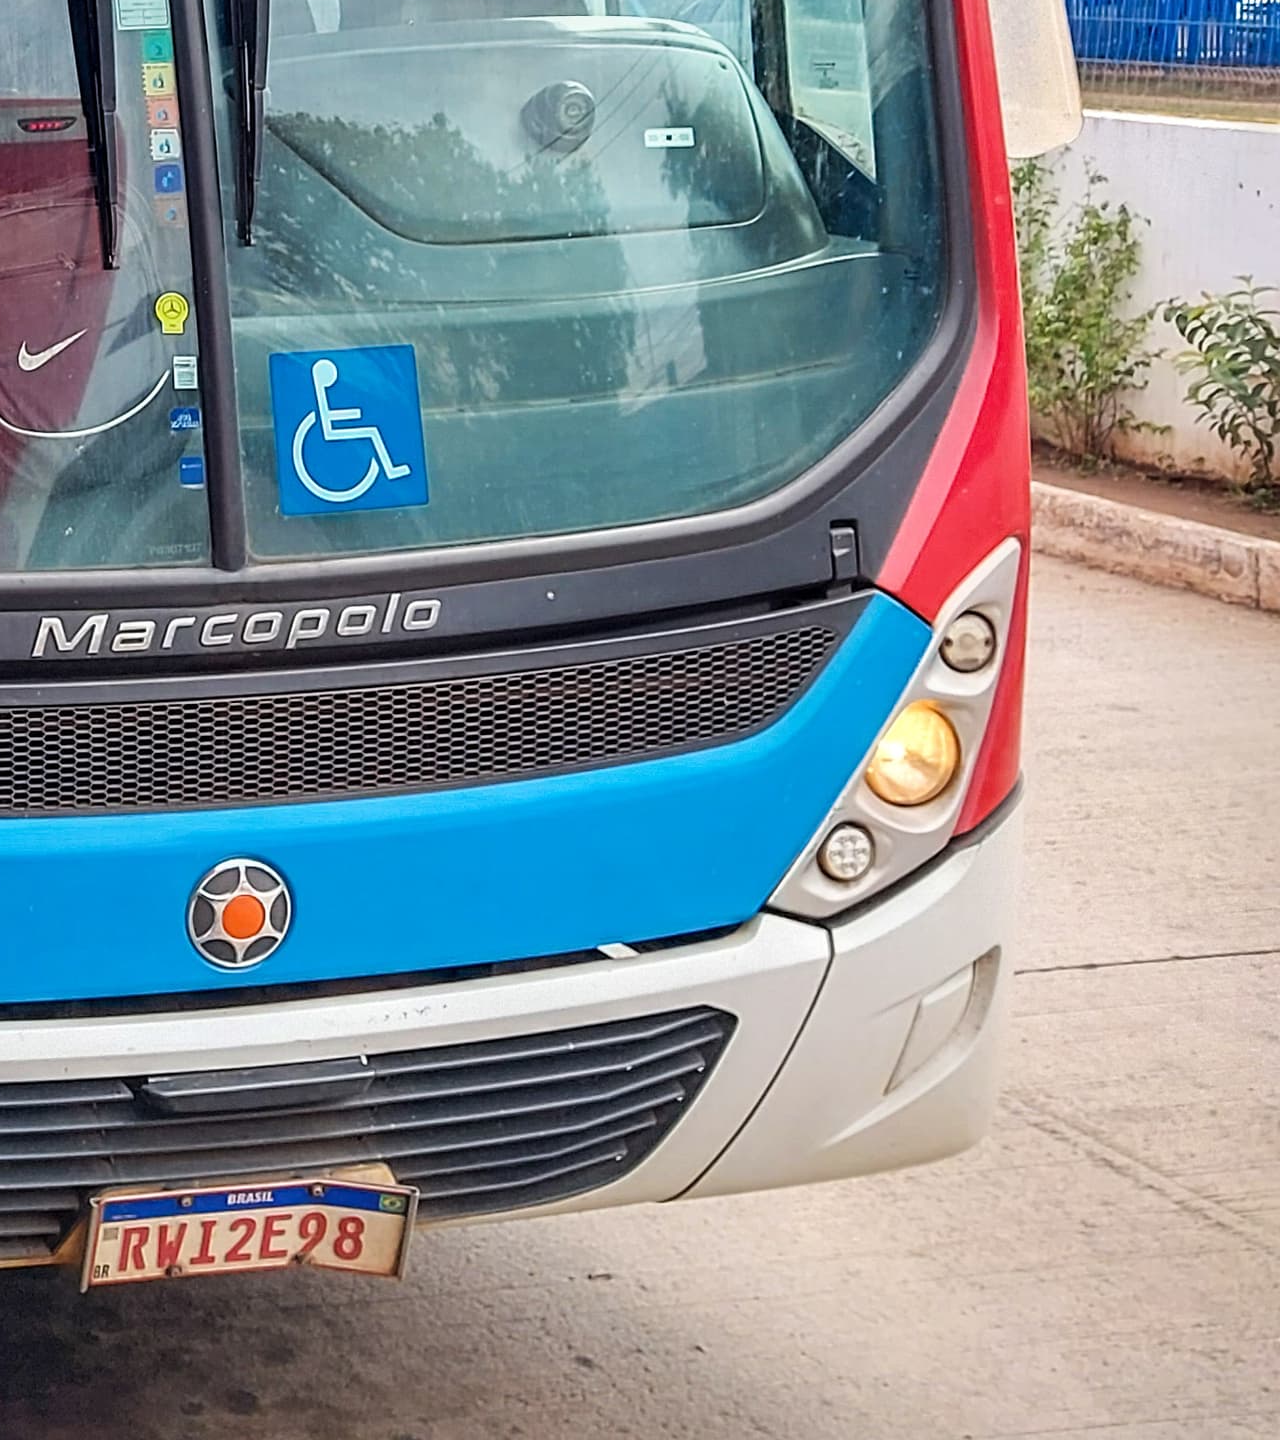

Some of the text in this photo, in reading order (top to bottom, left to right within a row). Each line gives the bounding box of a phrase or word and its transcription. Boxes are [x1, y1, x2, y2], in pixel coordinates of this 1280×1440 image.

[31, 592, 442, 658] Marcopolo
[226, 1191, 274, 1206] BRASIL
[117, 1211, 366, 1272] RWI2E98
[93, 1263, 110, 1279] BR
